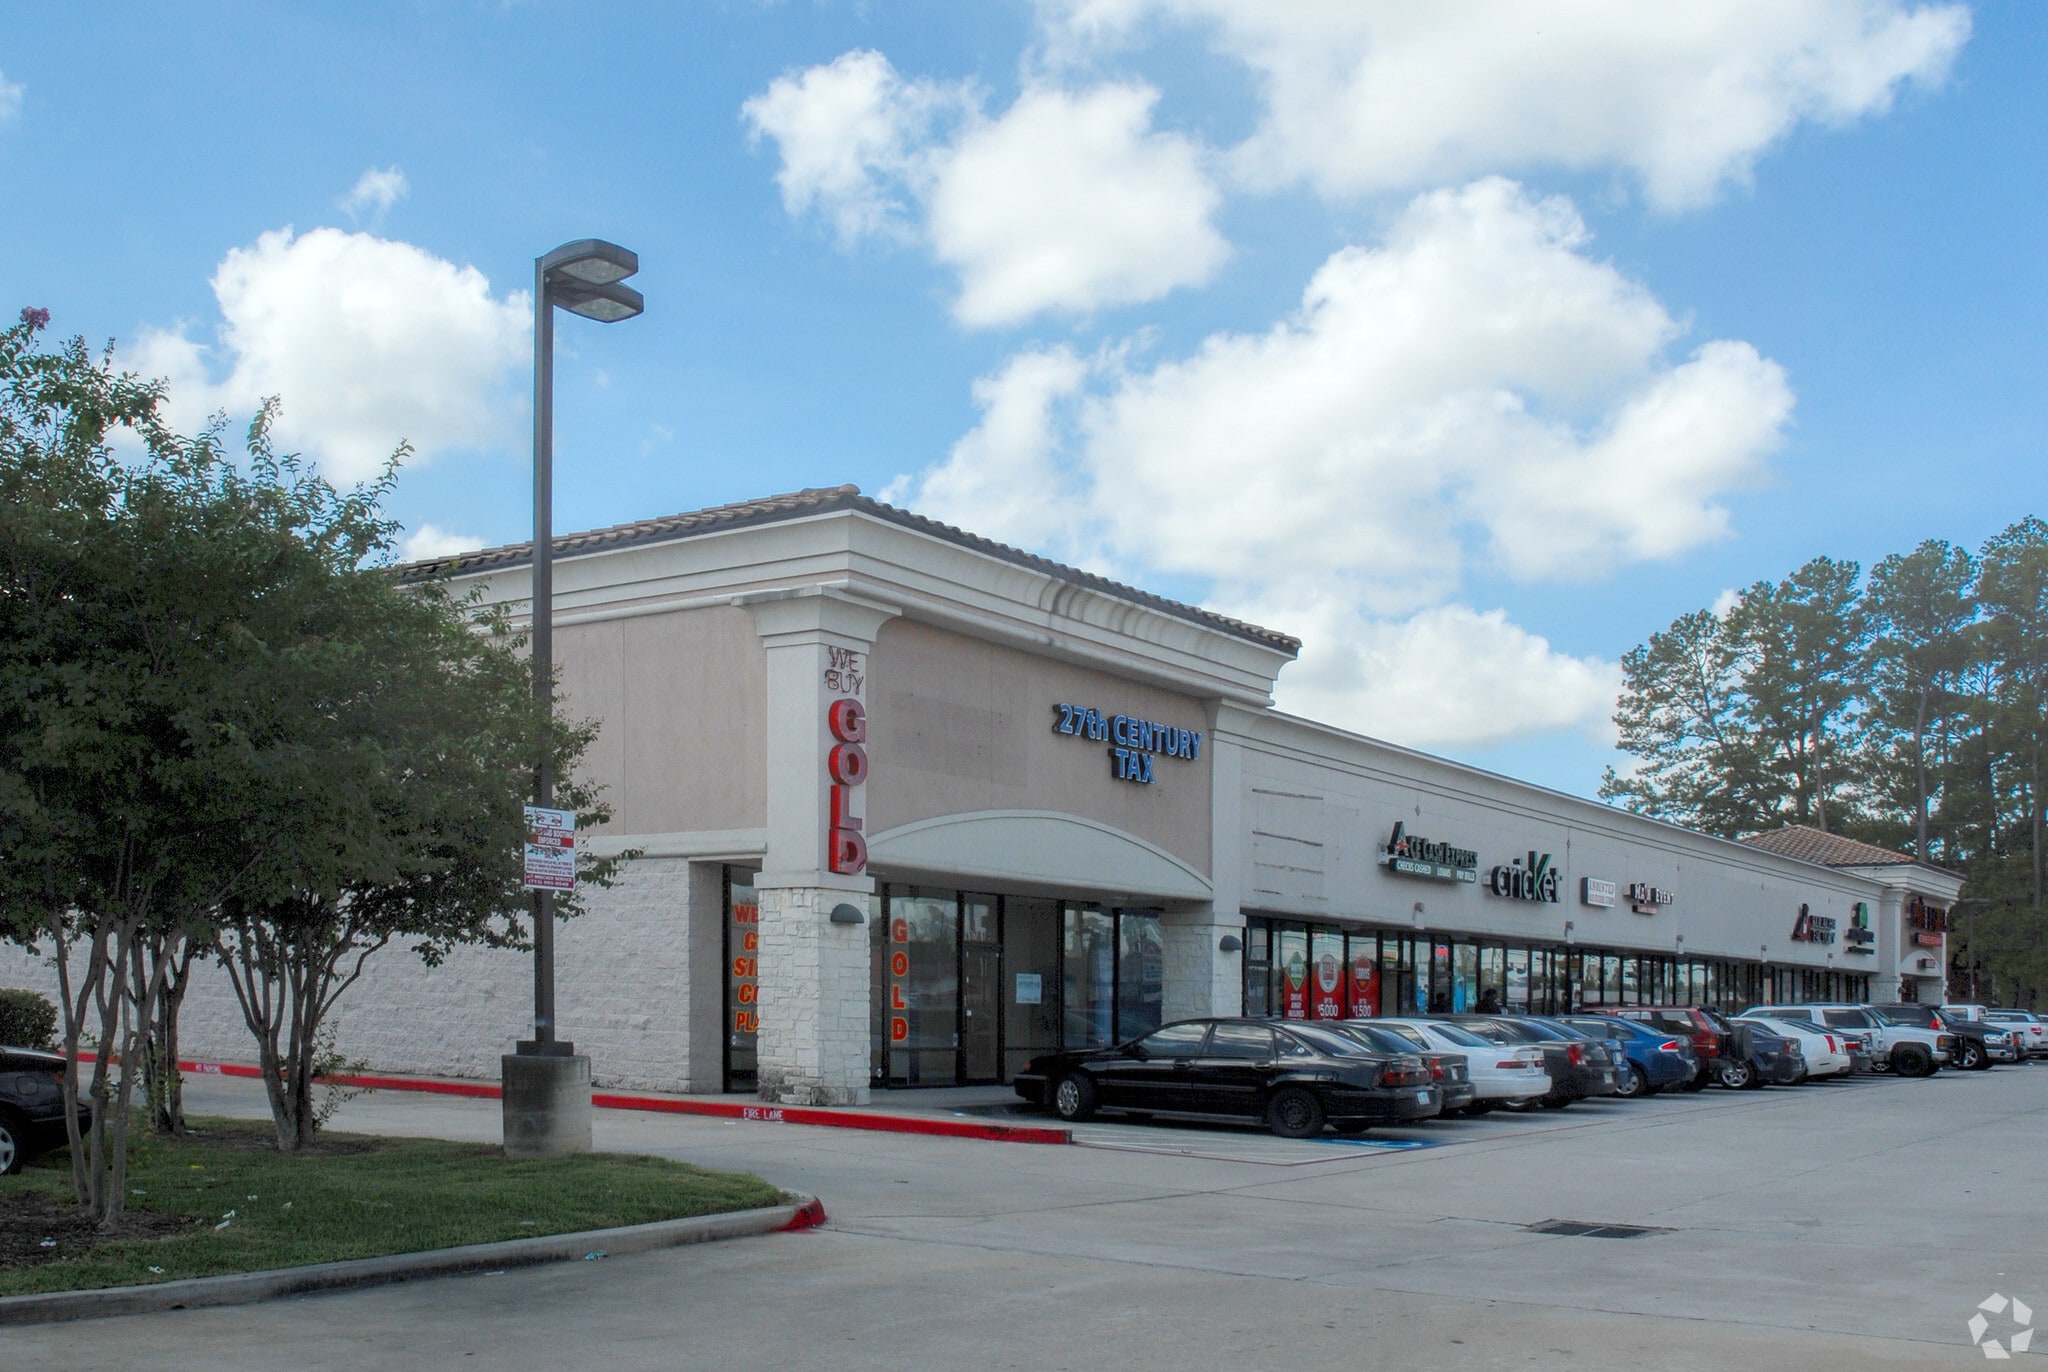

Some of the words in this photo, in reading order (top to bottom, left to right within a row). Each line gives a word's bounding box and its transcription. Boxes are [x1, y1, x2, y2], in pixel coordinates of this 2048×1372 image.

[829, 646, 858, 672] WE
[825, 669, 864, 695] BUY
[1054, 703, 1108, 741] 27th
[1109, 714, 1203, 760] CENTURY
[1110, 748, 1155, 784] TAX
[828, 698, 868, 874] GOLD
[1443, 842, 1478, 868] EXPRESS
[1396, 860, 1414, 872] CHECKS
[1414, 863, 1432, 875] CASHED
[1436, 866, 1451, 878] LOANS
[892, 918, 909, 1042] GOLD
[743, 1107, 760, 1120] FIRE
[763, 1108, 783, 1121] LANE
